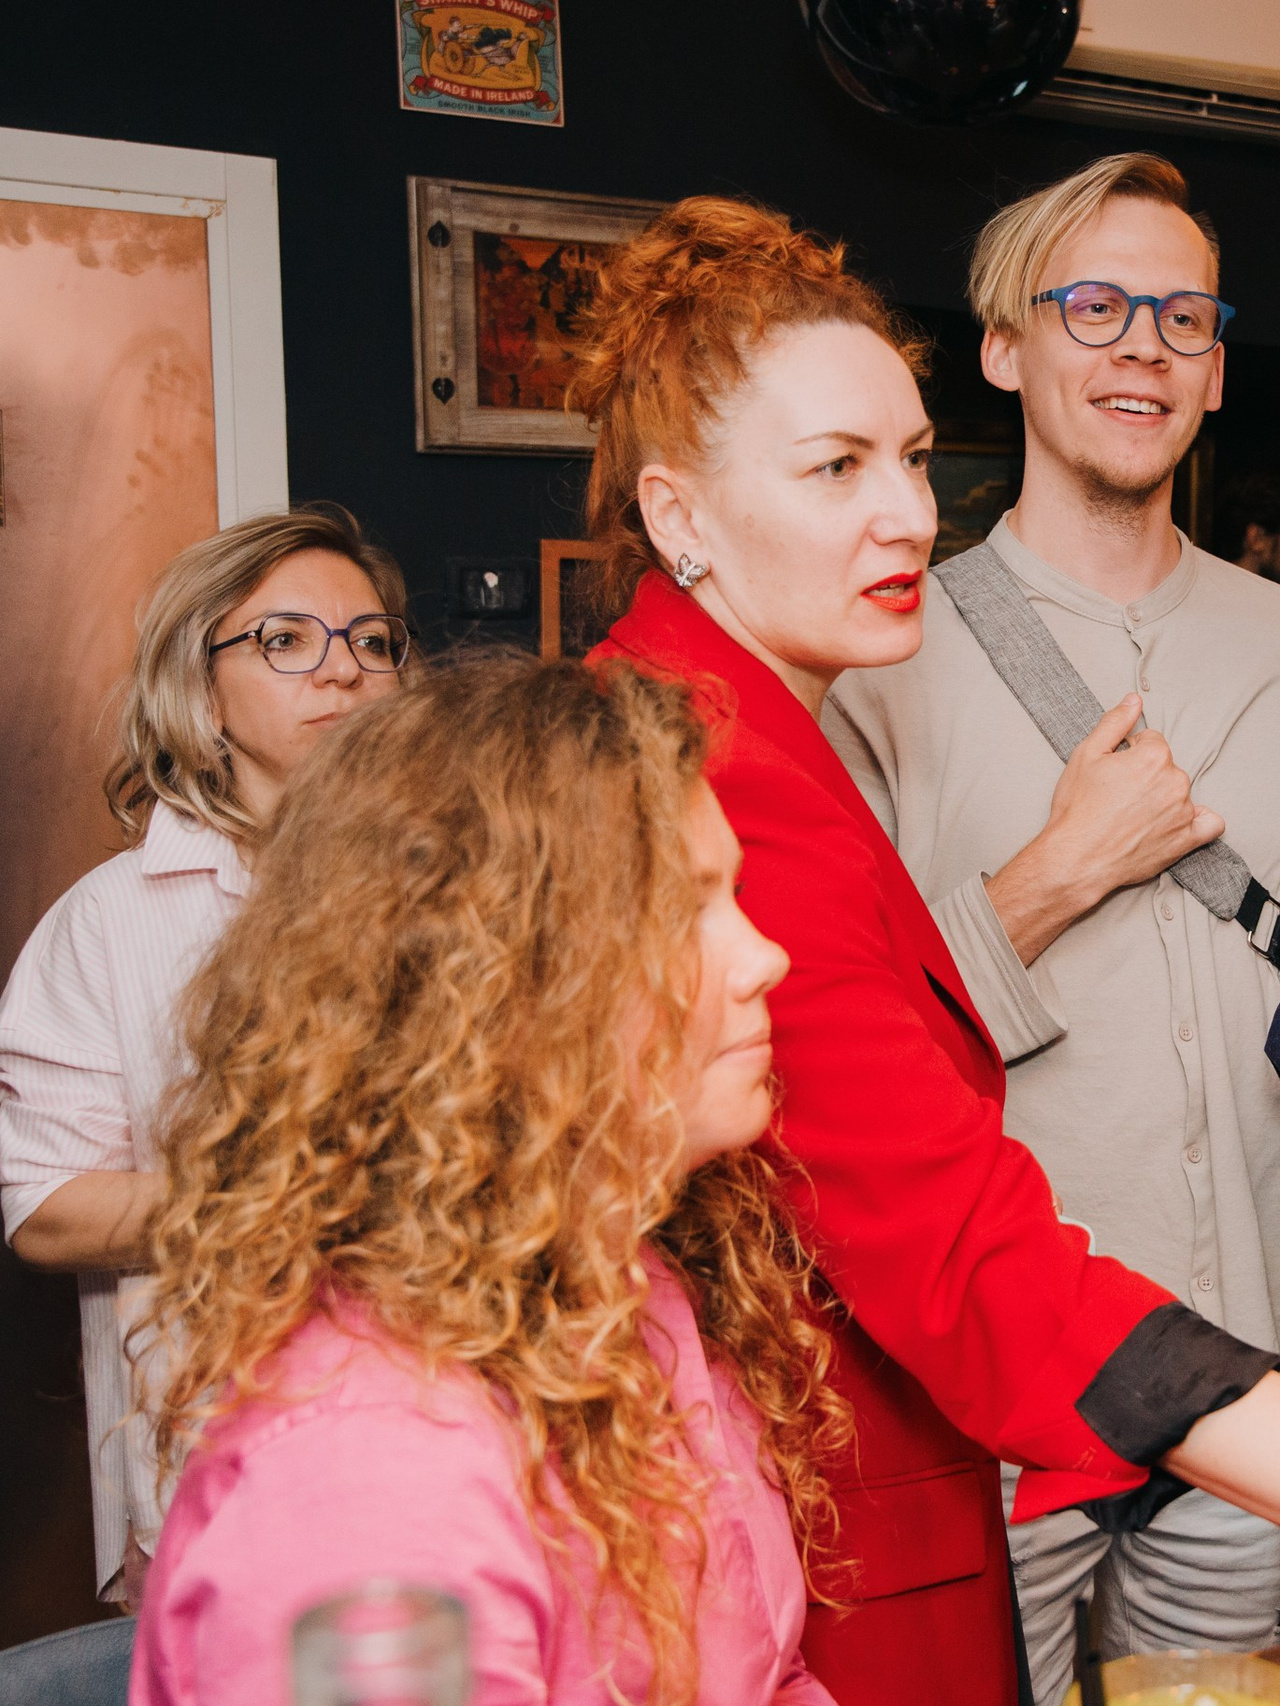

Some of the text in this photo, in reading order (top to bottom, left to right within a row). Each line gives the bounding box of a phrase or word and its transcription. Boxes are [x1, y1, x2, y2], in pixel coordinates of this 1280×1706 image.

[500, 1, 539, 19] WHIP
[433, 78, 534, 102] MADE IN IRELAND
[477, 104, 505, 115] BLACK
